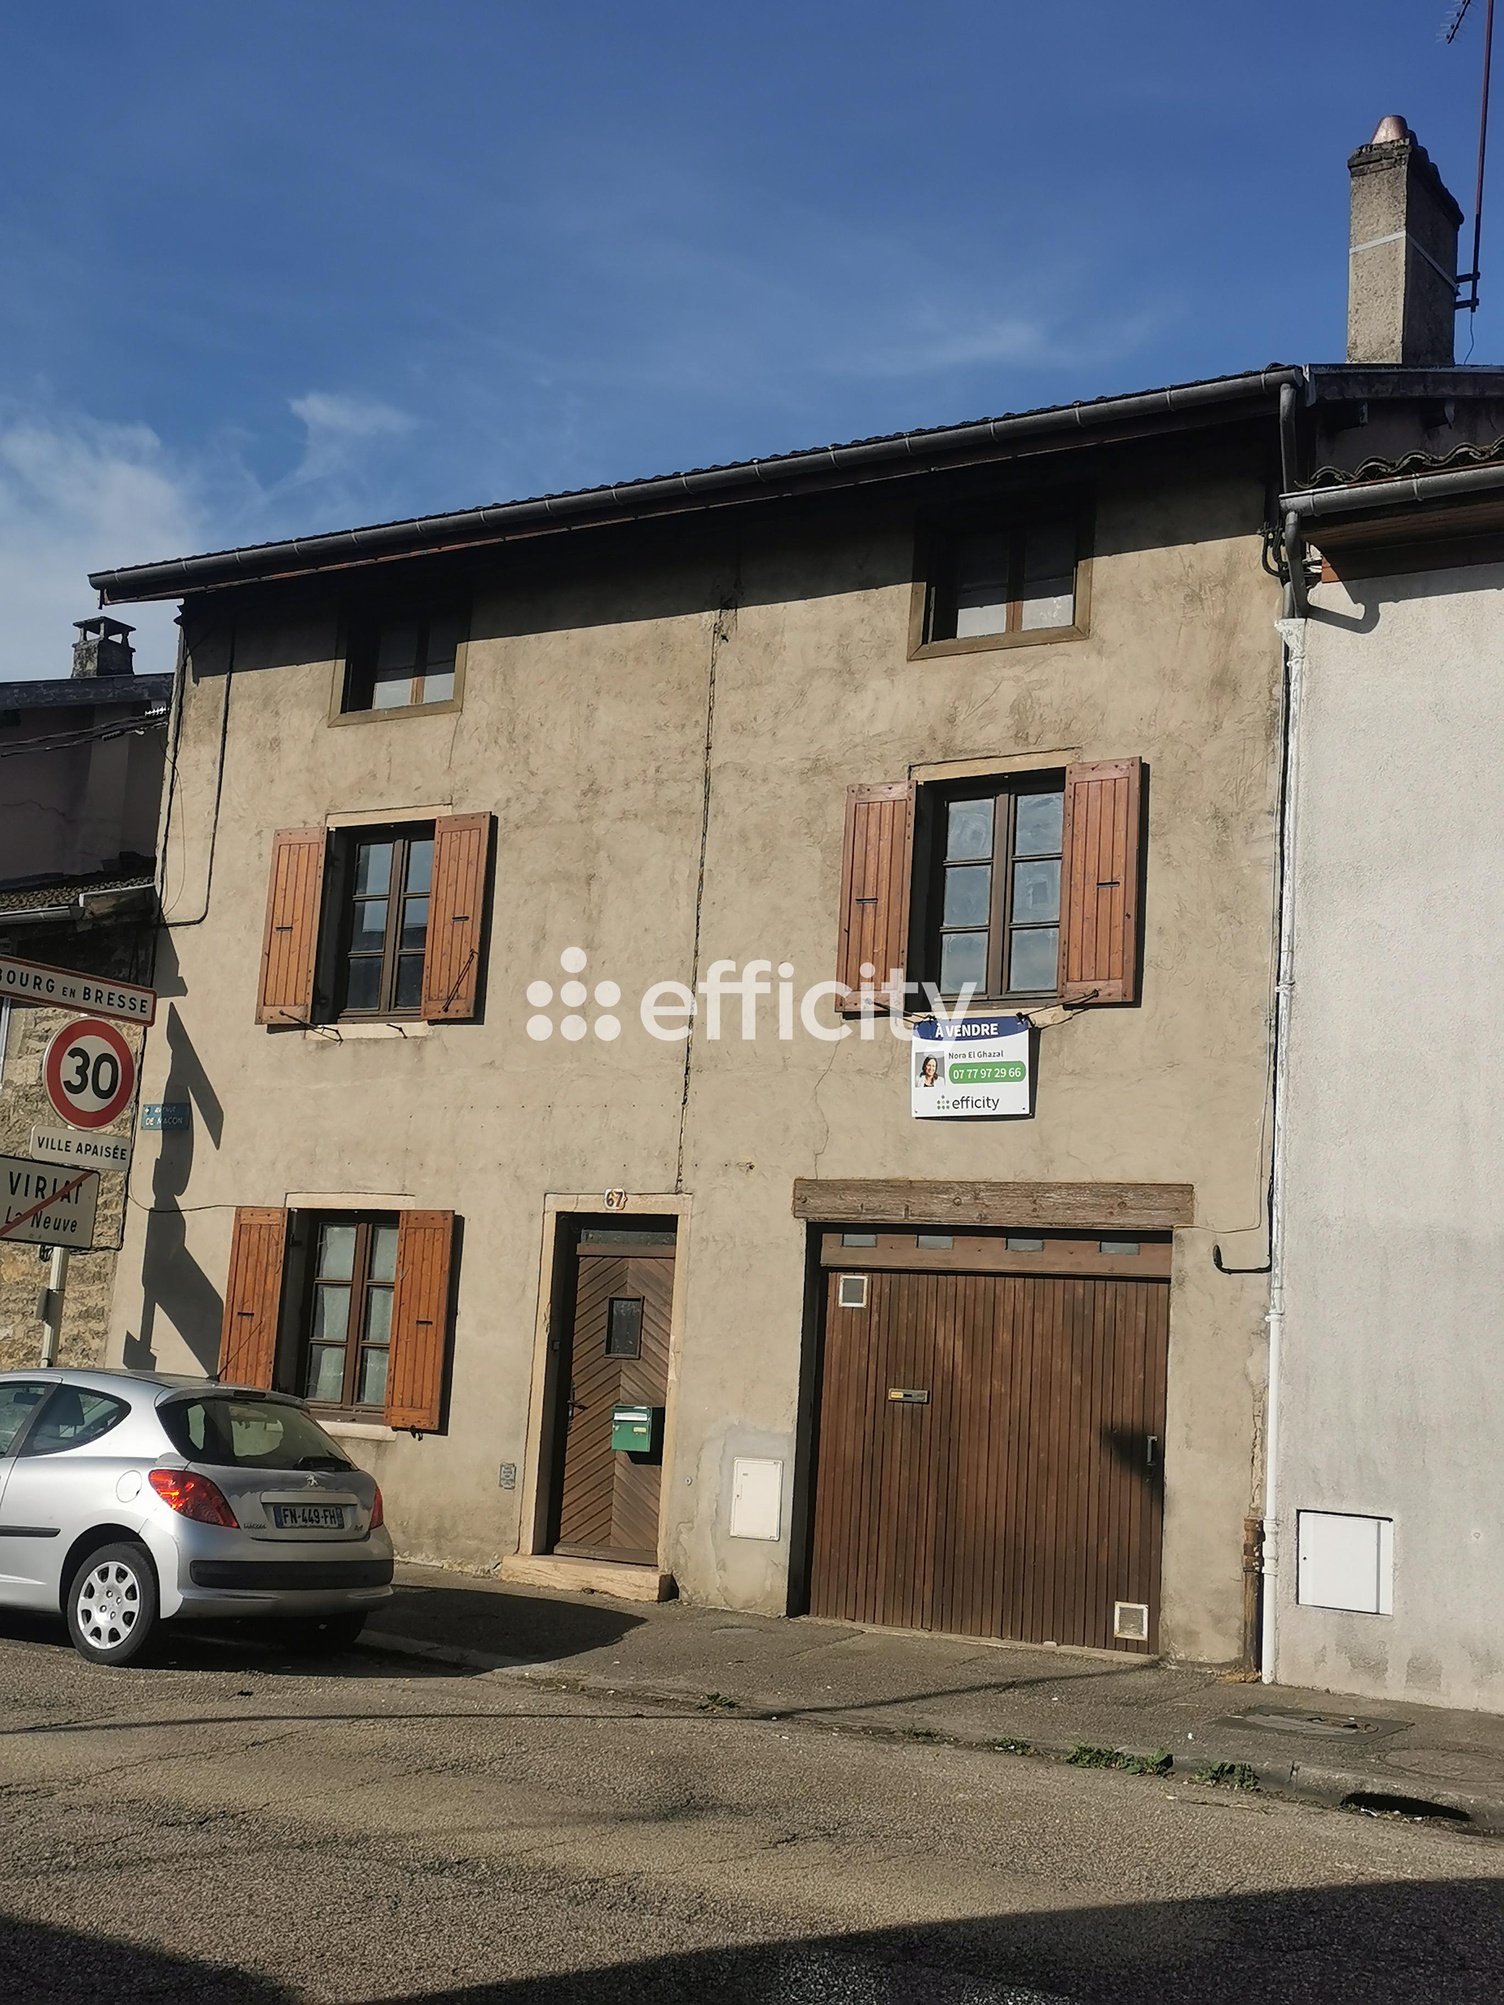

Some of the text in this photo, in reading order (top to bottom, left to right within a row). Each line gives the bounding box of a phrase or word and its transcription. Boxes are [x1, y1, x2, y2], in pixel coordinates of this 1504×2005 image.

[62, 987, 76, 998] EN
[83, 986, 148, 1014] BRESSE
[945, 1023, 999, 1038] VENDRE
[948, 1050, 1004, 1060] Nora El Ghazal
[63, 1047, 119, 1099] 30
[953, 1067, 1021, 1080] 07 77 97 29 66
[952, 1095, 1000, 1111] efficity
[37, 1136, 128, 1160] VILLE APAISÉE
[9, 1171, 82, 1205] VIRIAT
[607, 1191, 623, 1208] 67
[31, 1210, 77, 1233] Neuve
